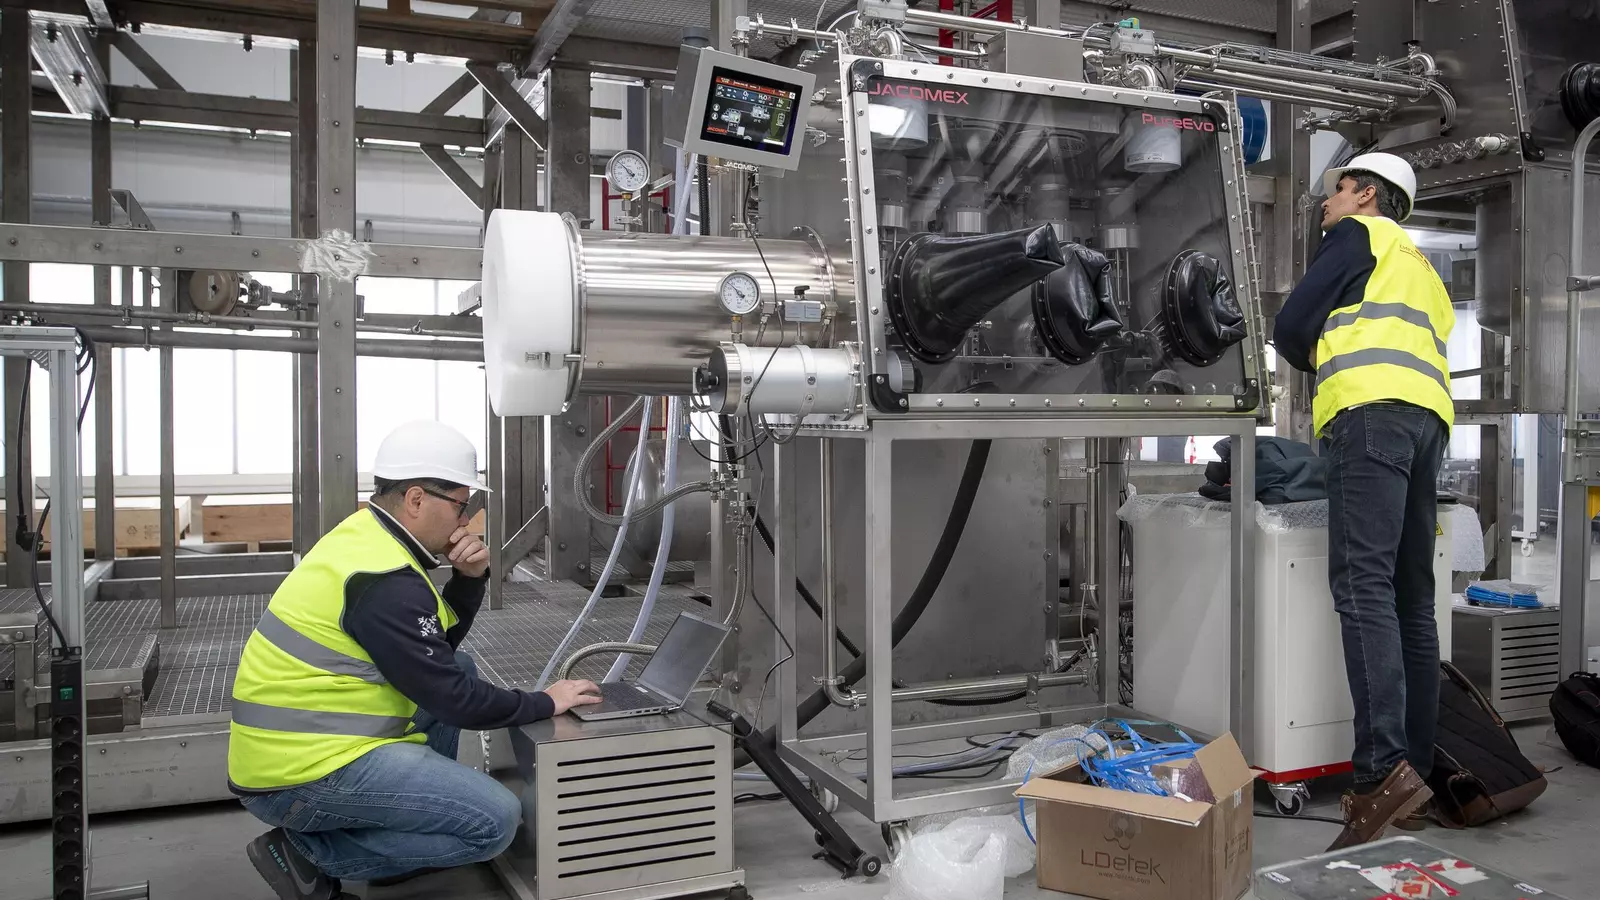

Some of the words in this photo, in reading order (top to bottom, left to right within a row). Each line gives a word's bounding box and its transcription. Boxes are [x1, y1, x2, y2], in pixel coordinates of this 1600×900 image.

[868, 82, 969, 105] JACOMEX
[1141, 112, 1215, 132] PureEvo
[724, 161, 759, 172] JACOMEX
[1080, 848, 1166, 885] LDetek
